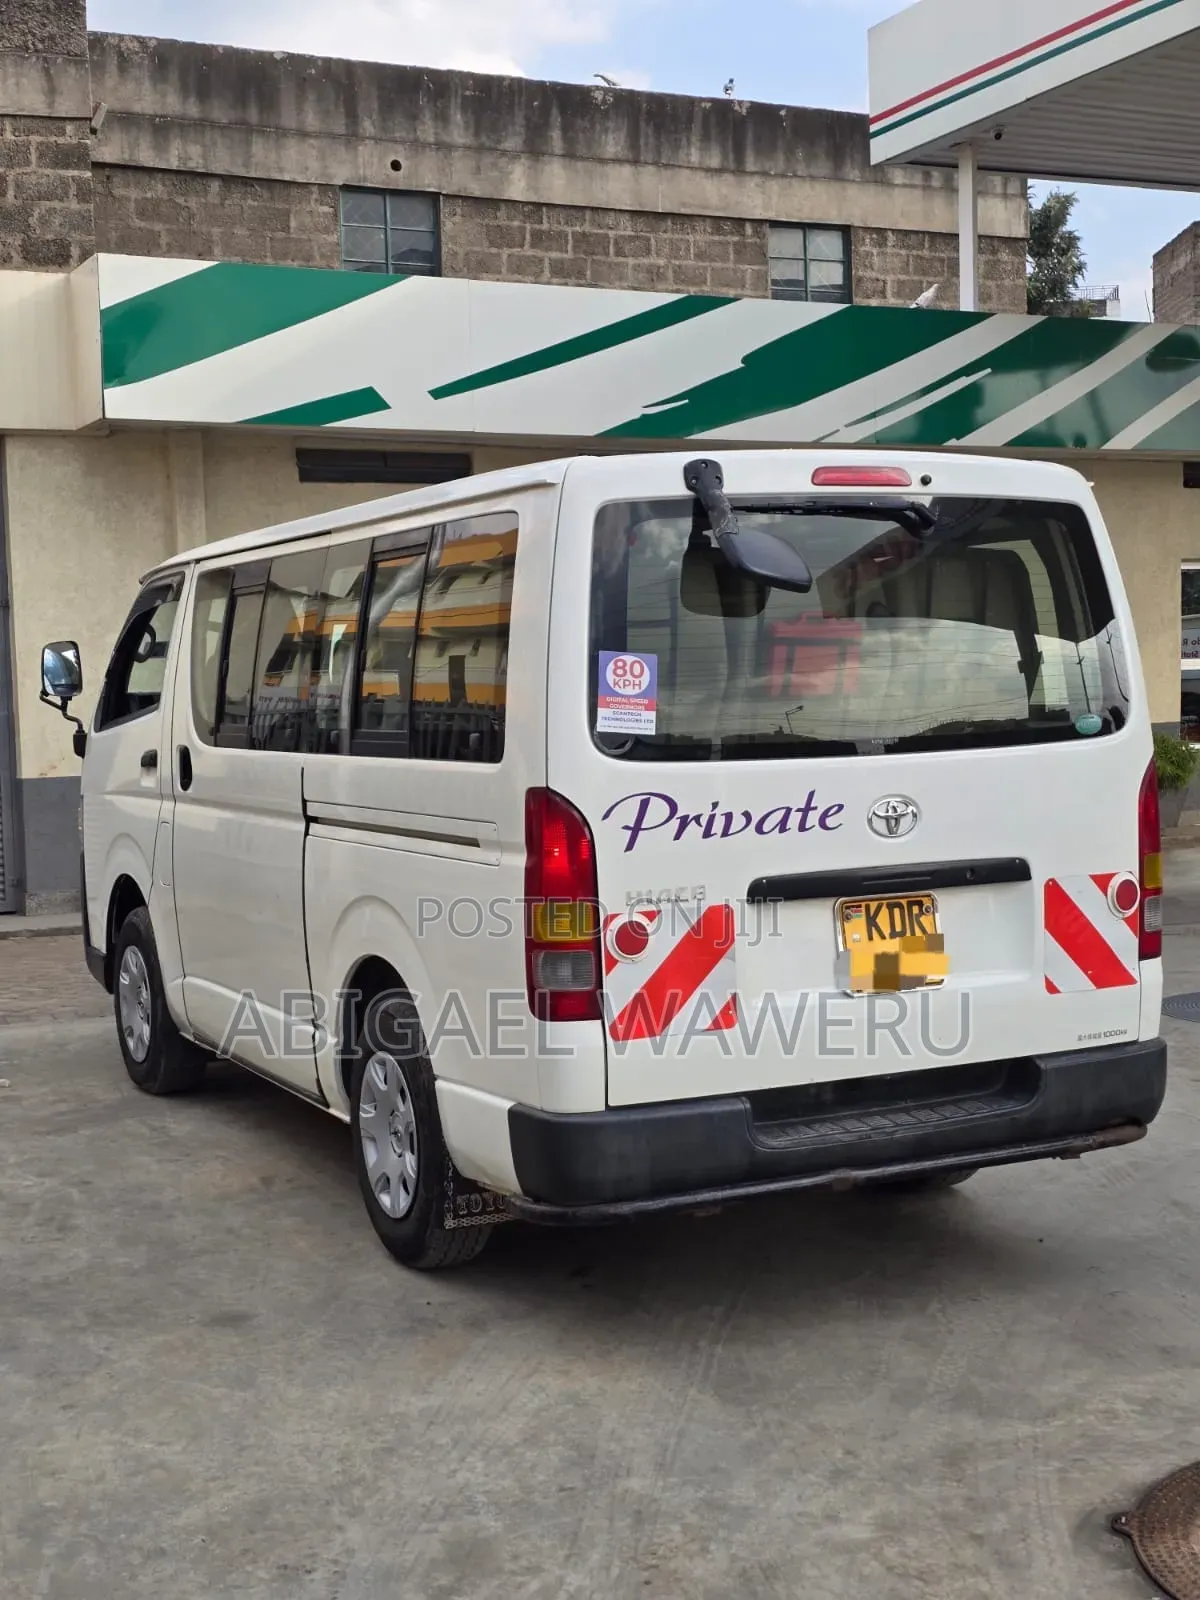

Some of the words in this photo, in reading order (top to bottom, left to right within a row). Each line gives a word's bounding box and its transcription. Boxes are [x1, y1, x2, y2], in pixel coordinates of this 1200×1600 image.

[612, 658, 645, 678] 80
[613, 679, 642, 690] KPH
[601, 789, 845, 853] Private
[864, 898, 930, 941] KDR
